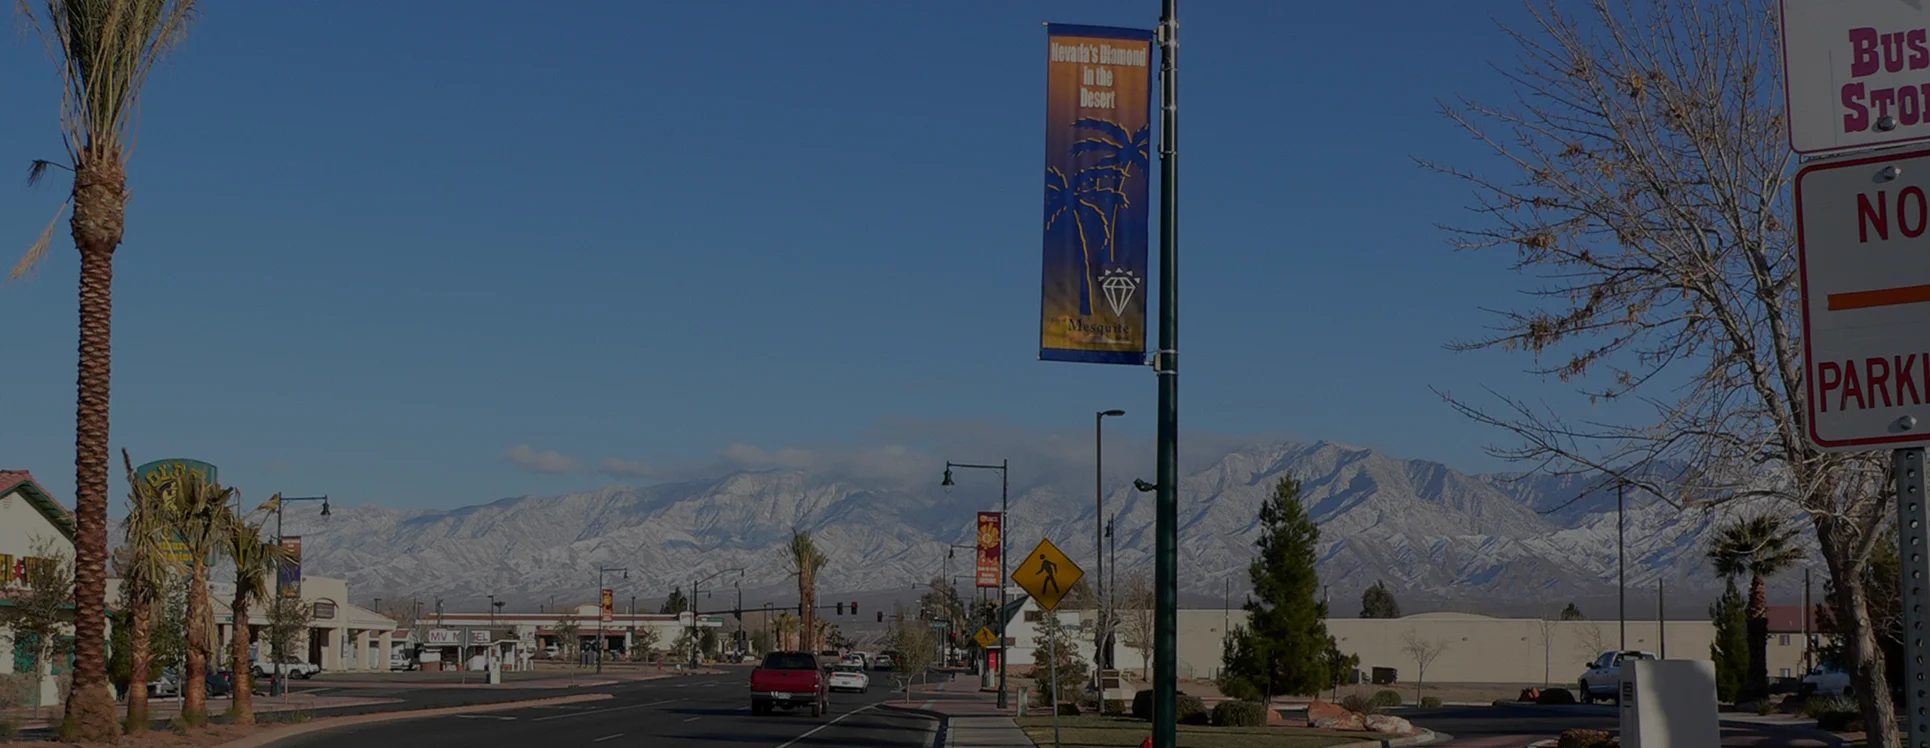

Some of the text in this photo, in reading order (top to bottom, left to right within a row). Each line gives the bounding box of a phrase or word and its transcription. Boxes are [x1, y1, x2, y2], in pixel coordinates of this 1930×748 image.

[1051, 42, 1146, 67] Nevada's Diamond
[1848, 26, 1930, 78] BUS
[1095, 66, 1113, 87] the
[1080, 87, 1115, 109] Desert
[1857, 185, 1928, 243] NO
[1067, 318, 1129, 336] Mesquite
[431, 632, 447, 641] MV
